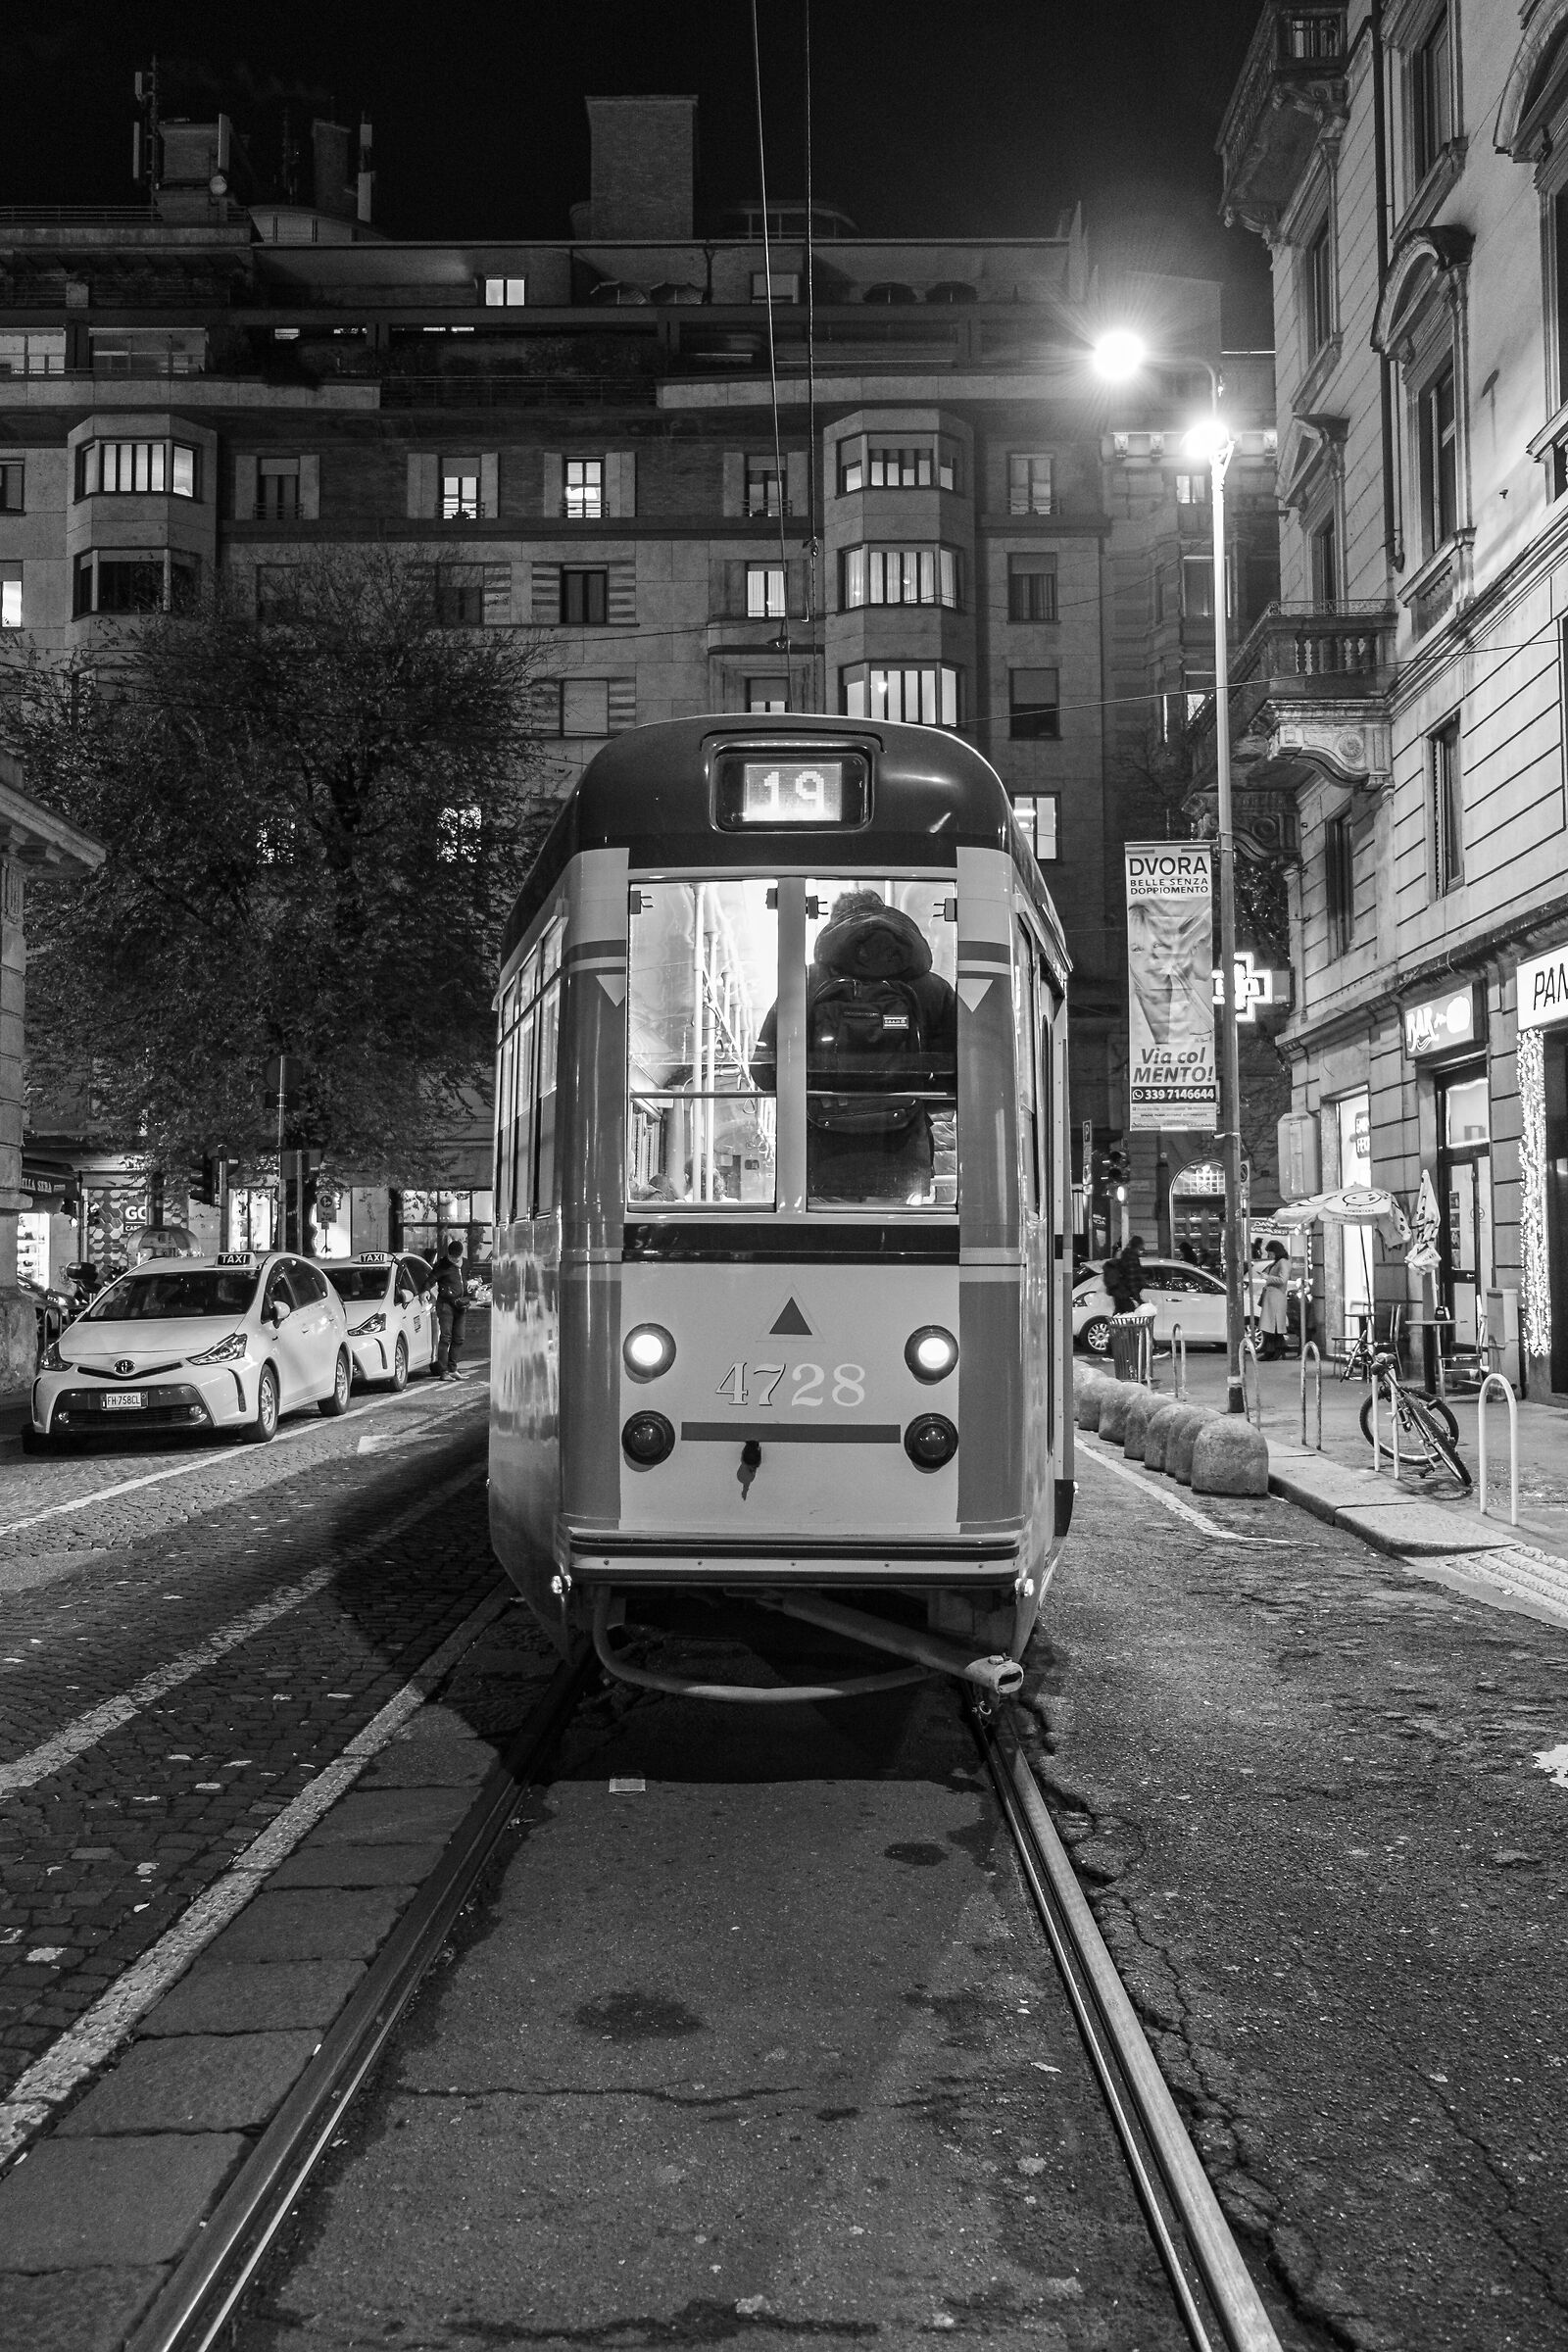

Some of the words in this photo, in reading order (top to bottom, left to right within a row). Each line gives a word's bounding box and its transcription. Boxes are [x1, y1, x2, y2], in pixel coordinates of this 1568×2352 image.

[763, 770, 824, 812] 19
[1129, 856, 1208, 876] DVORA
[1130, 878, 1165, 887] BELLE
[1169, 877, 1208, 886] SENZA
[1130, 885, 1208, 895] DOPPIOMENTO
[1404, 1005, 1440, 1052] BAR
[1141, 1047, 1172, 1064] Via
[1177, 1047, 1205, 1063] col
[1133, 1065, 1213, 1083] MENTO!
[1145, 1089, 1165, 1100] 339
[1166, 1088, 1214, 1100] 7146644
[220, 1254, 247, 1264] TAXI
[362, 1253, 384, 1262] TAXI
[714, 1362, 865, 1407] 4728
